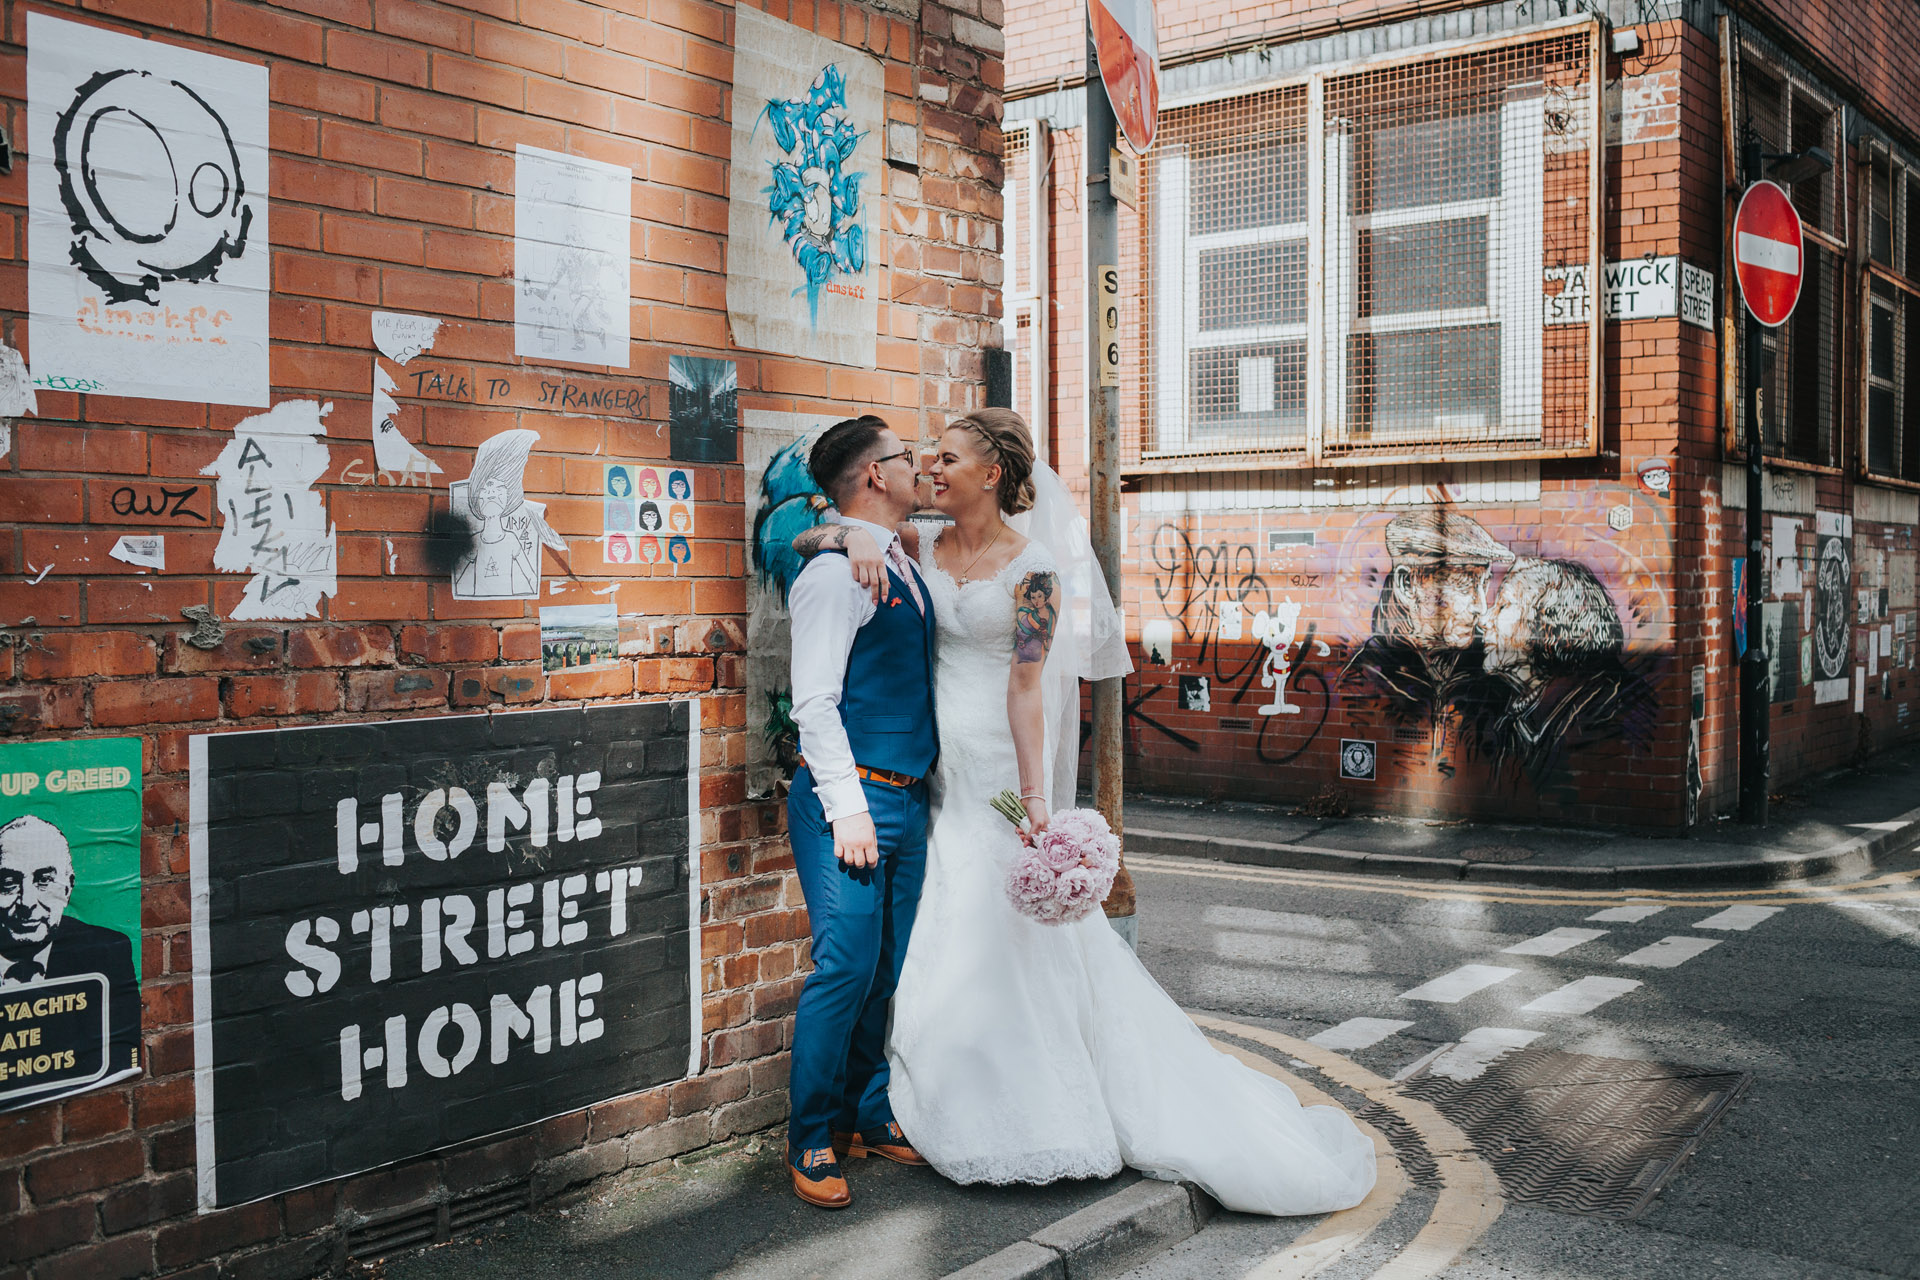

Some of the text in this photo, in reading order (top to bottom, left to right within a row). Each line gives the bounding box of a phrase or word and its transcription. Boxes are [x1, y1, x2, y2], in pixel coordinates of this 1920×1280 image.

[1547, 263, 1671, 293] WAWICK
[1684, 268, 1712, 299] SPEAR
[1550, 291, 1640, 318] STRET
[1683, 294, 1711, 322] STREET
[409, 369, 648, 418] TALK TO STRANGERS
[0, 766, 131, 797] UP GREED
[336, 770, 603, 875] HOME
[284, 866, 643, 998] STREET
[339, 972, 605, 1102] HOME
